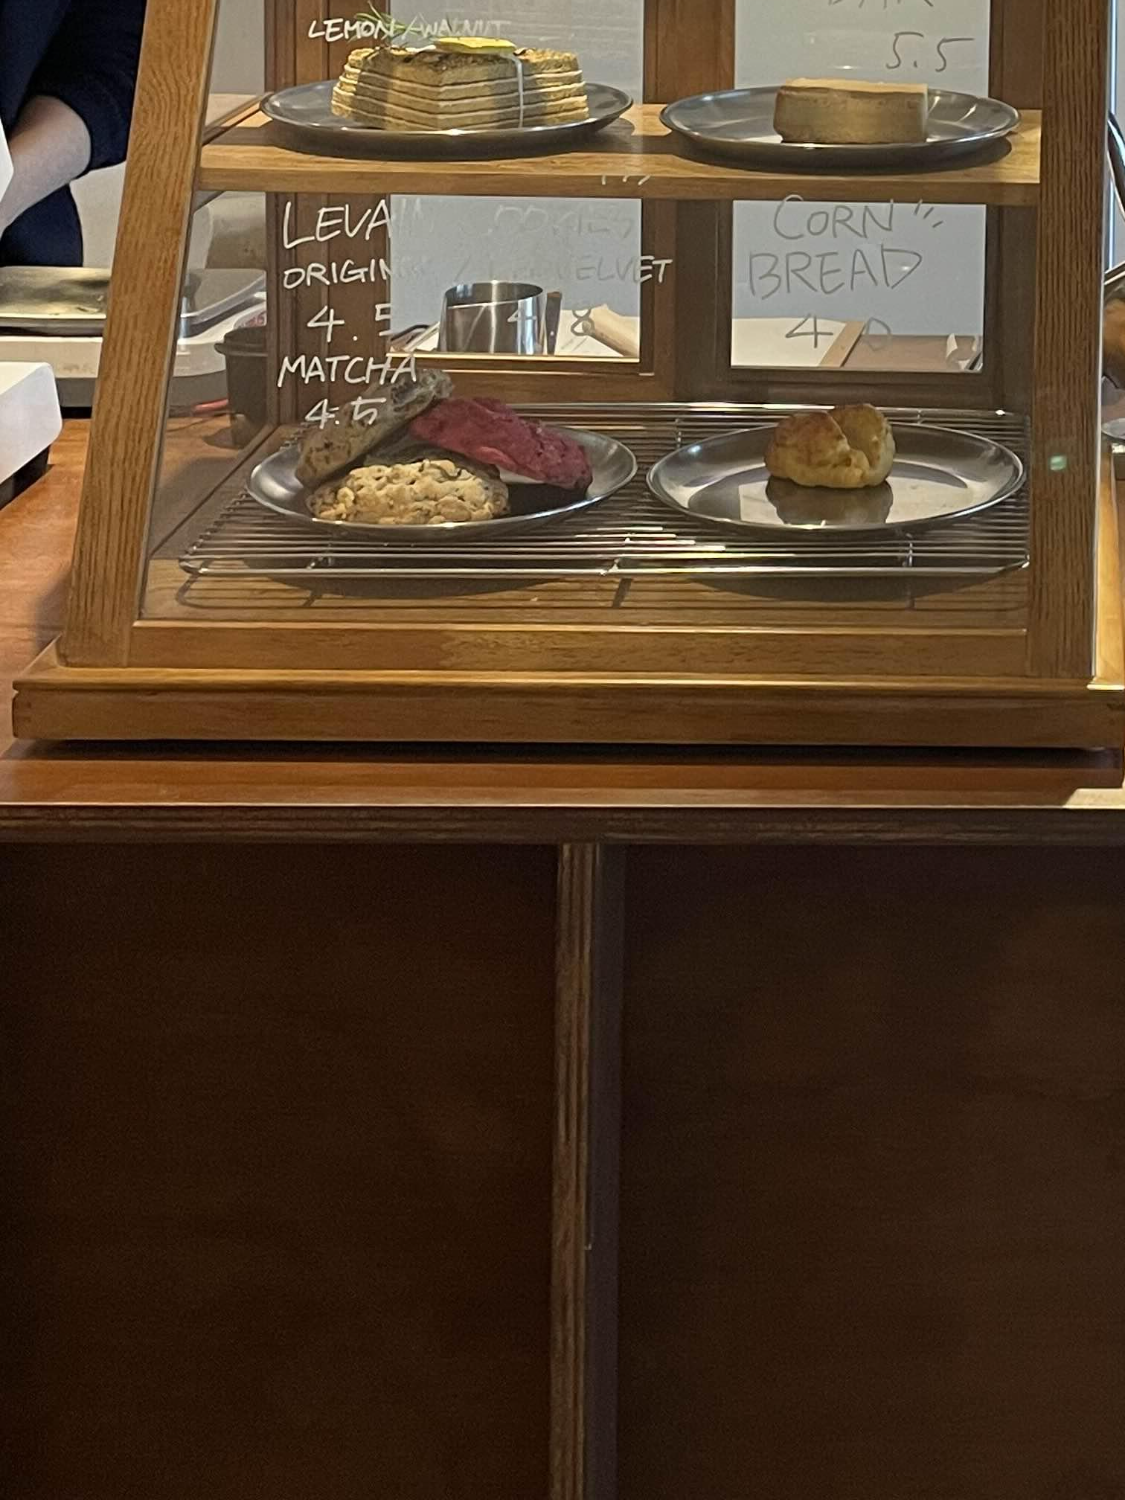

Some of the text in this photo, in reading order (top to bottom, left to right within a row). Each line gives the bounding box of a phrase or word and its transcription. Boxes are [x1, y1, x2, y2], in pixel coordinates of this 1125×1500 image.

[307, 16, 397, 43] LEMON
[885, 31, 975, 73] 5.5
[773, 193, 894, 240] CORN
[750, 243, 923, 300] BREAD
[276, 354, 418, 388] MATCHA
